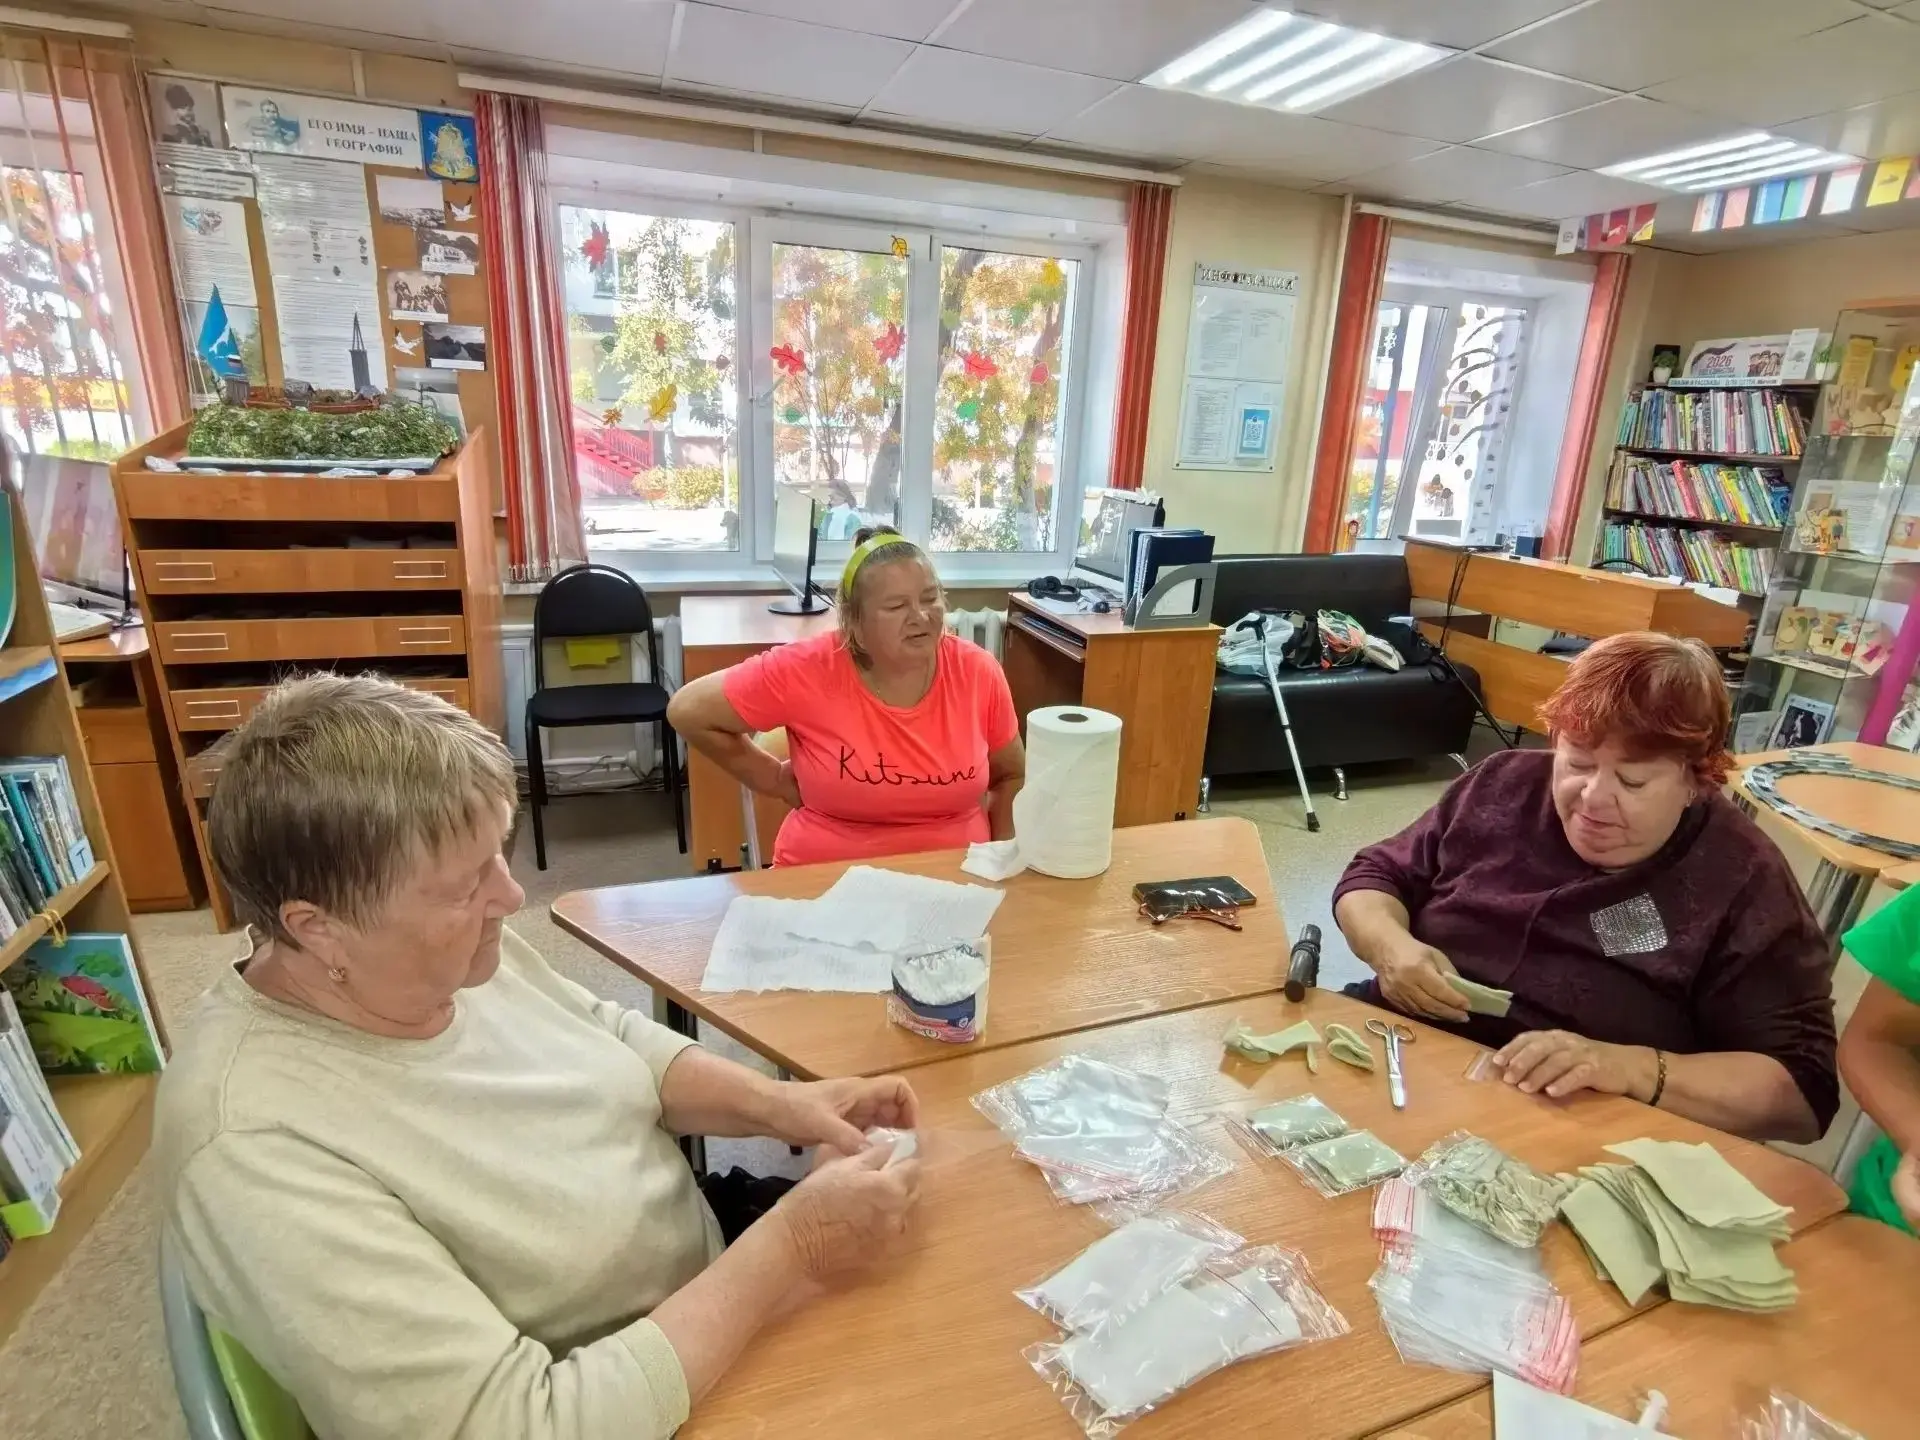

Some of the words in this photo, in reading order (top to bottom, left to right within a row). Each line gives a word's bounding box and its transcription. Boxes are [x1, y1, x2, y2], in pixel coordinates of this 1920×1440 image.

[307, 119, 333, 131] ЕГО
[335, 122, 365, 135] ИМЯ
[377, 127, 418, 142] НАША
[325, 137, 404, 156] ГЕОГРАФИЯ
[1200, 268, 1295, 291] ИНФОРМАЦИЯ
[1706, 355, 1733, 368] 2026
[840, 745, 976, 786] Kitsune
